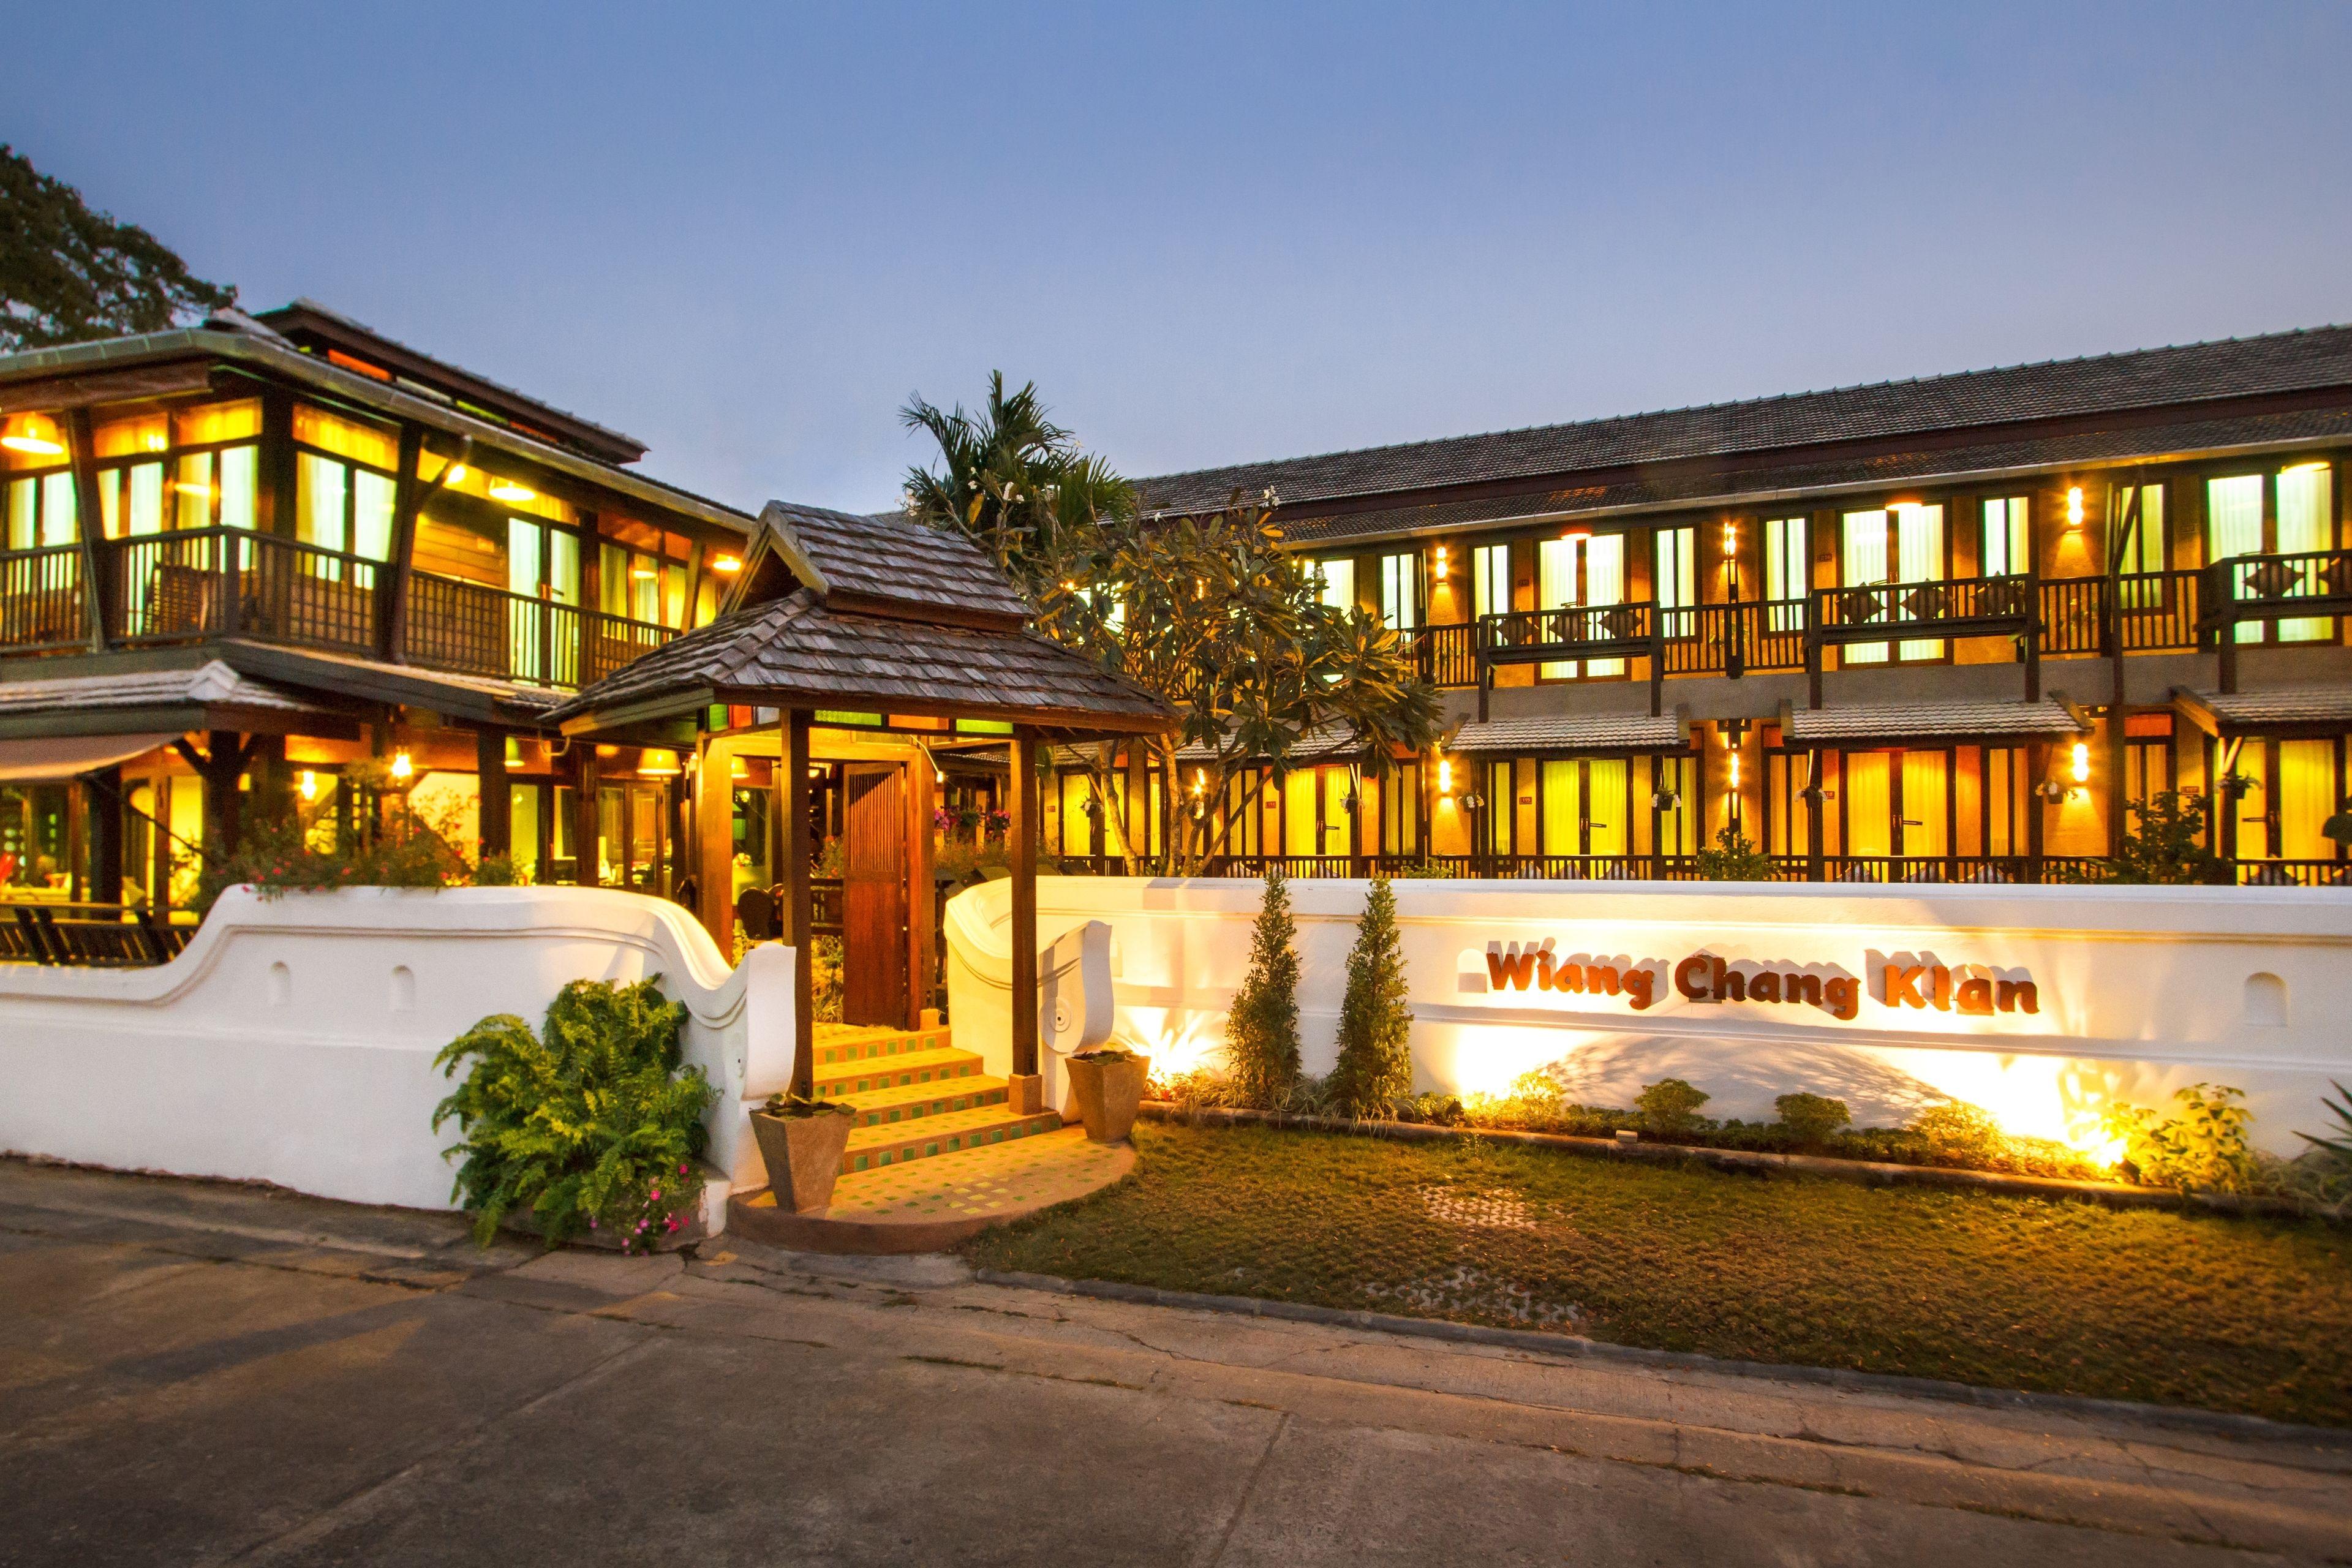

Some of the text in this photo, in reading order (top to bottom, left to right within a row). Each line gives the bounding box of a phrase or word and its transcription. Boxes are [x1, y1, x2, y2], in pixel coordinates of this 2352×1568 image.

[1487, 949, 2040, 1020] Wiang Chang Klan
